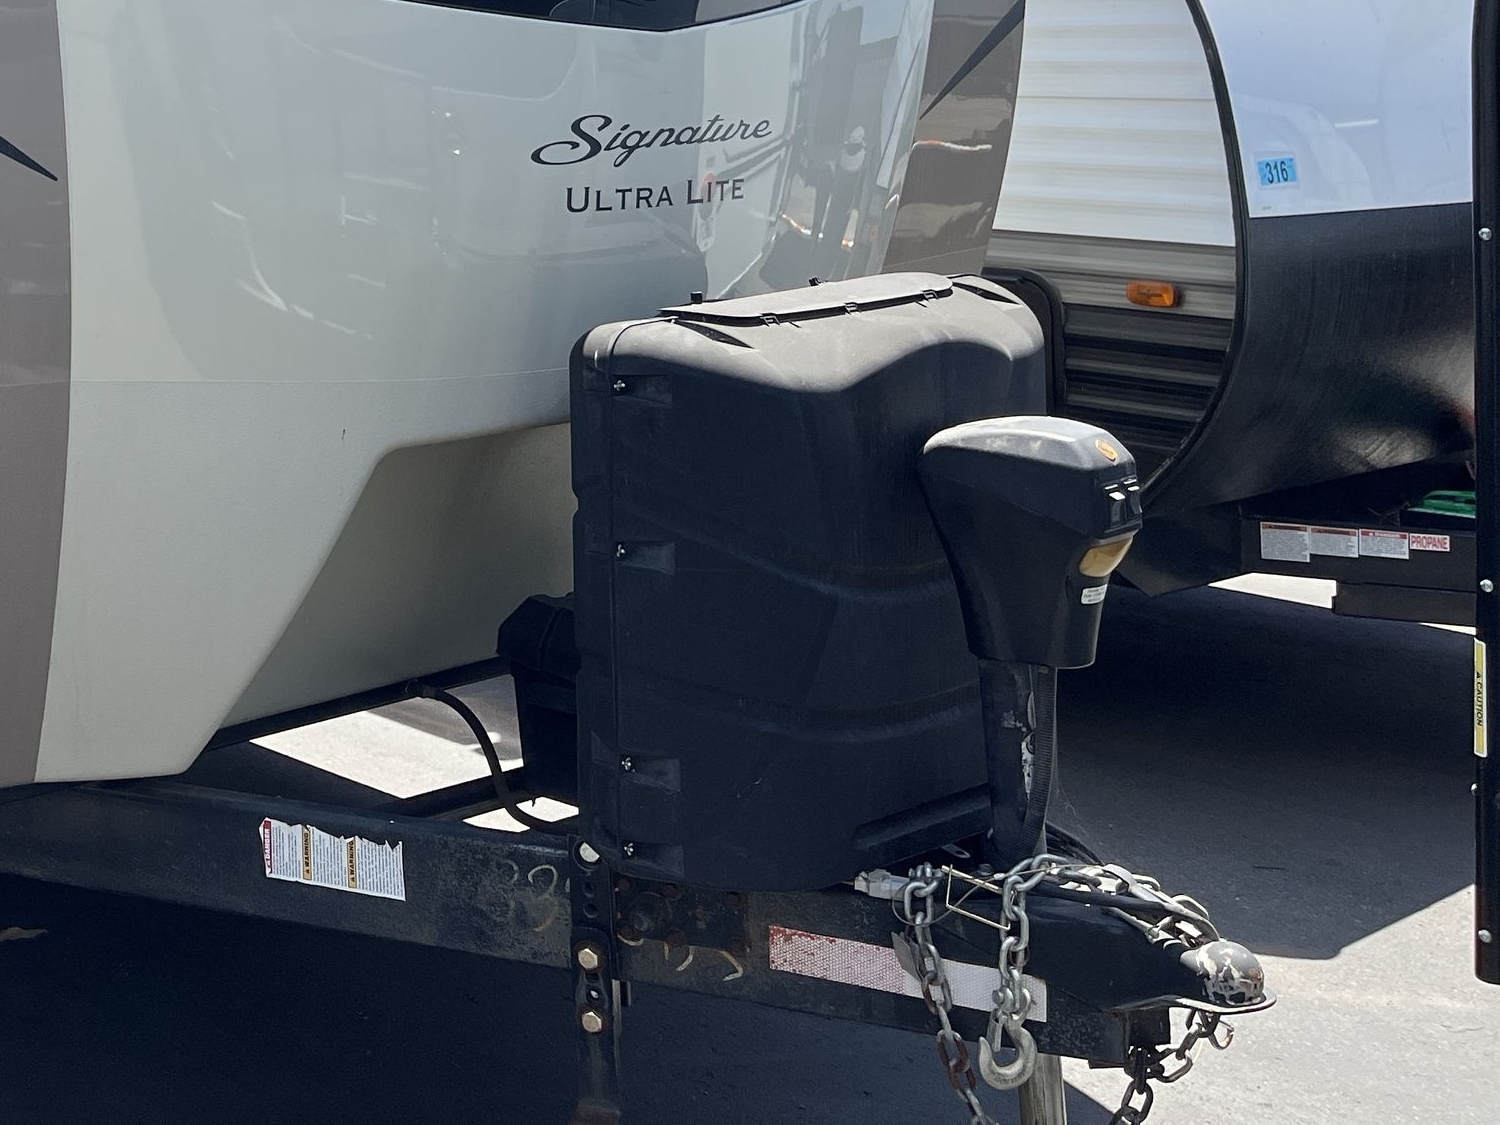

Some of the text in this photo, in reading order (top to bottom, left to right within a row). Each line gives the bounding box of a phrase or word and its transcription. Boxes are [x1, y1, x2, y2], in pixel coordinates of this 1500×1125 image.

[530, 114, 773, 167] Signature
[1265, 160, 1289, 184] 316
[566, 178, 745, 213] ULTRA LITE
[1411, 535, 1448, 550] PROPANE
[1476, 682, 1484, 727] CAUTION
[263, 828, 271, 860] DANGER
